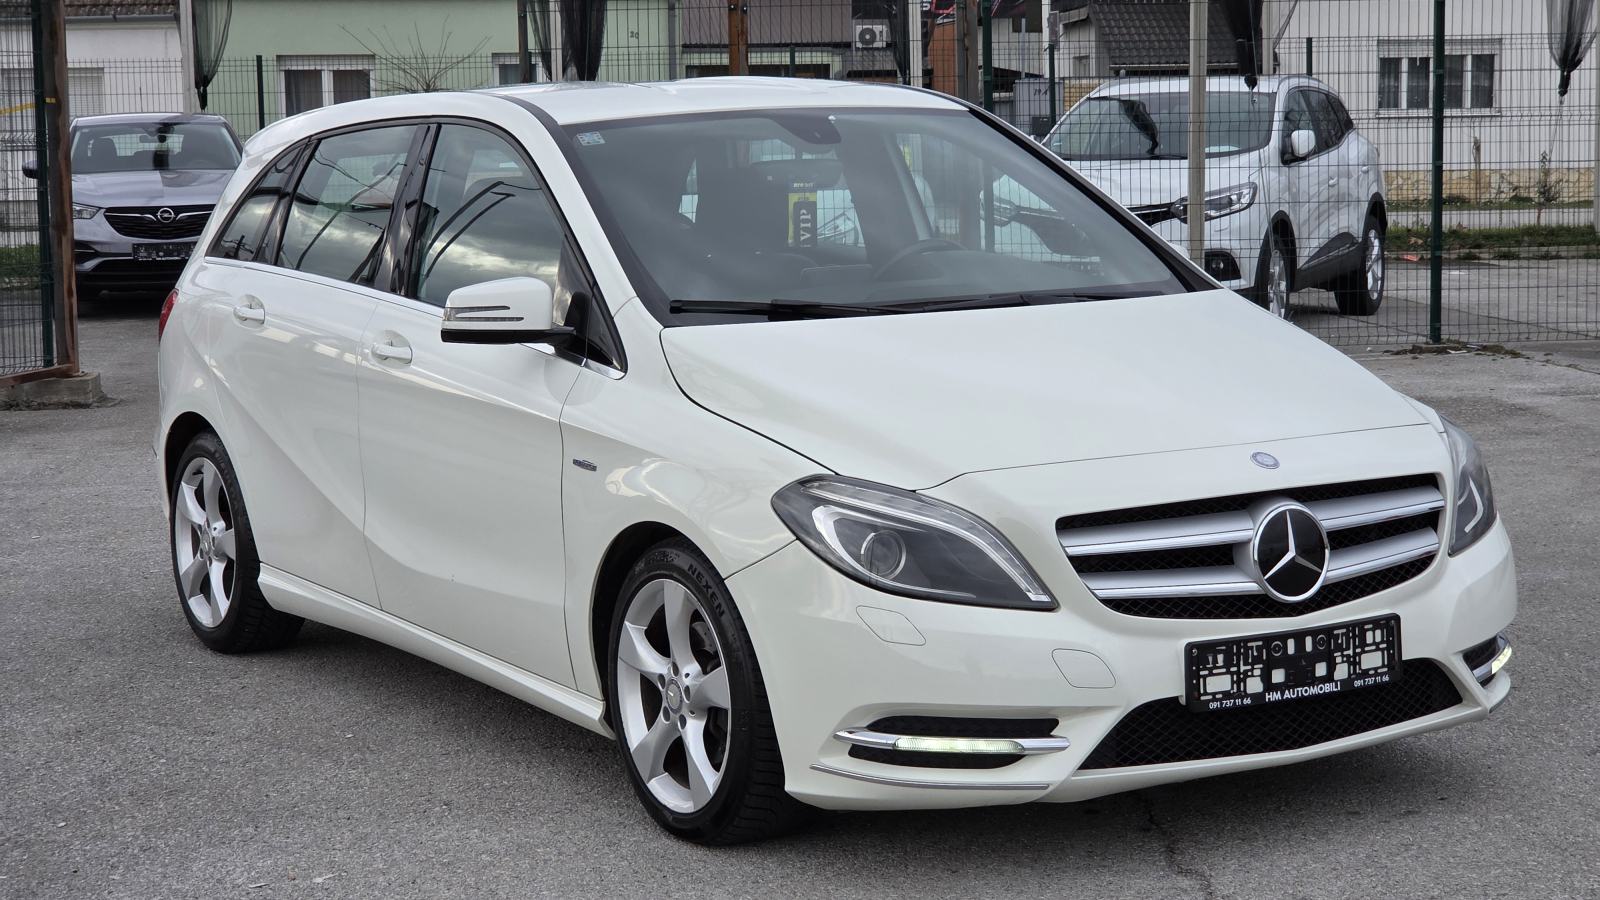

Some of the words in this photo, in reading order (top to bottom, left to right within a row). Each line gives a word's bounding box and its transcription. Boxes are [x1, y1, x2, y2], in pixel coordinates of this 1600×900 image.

[800, 209, 812, 241] VIP
[687, 563, 725, 617] NEXEN
[1354, 679, 1364, 687] 091
[1365, 676, 1375, 685] 737
[1376, 675, 1381, 683] 11
[1382, 674, 1389, 682] 66
[1265, 690, 1282, 702] HM
[1283, 681, 1341, 700] AUTOMOBILI
[1209, 700, 1220, 709] 091
[1222, 699, 1234, 708] 737
[1236, 698, 1241, 706] 11
[1243, 697, 1252, 705] 66
